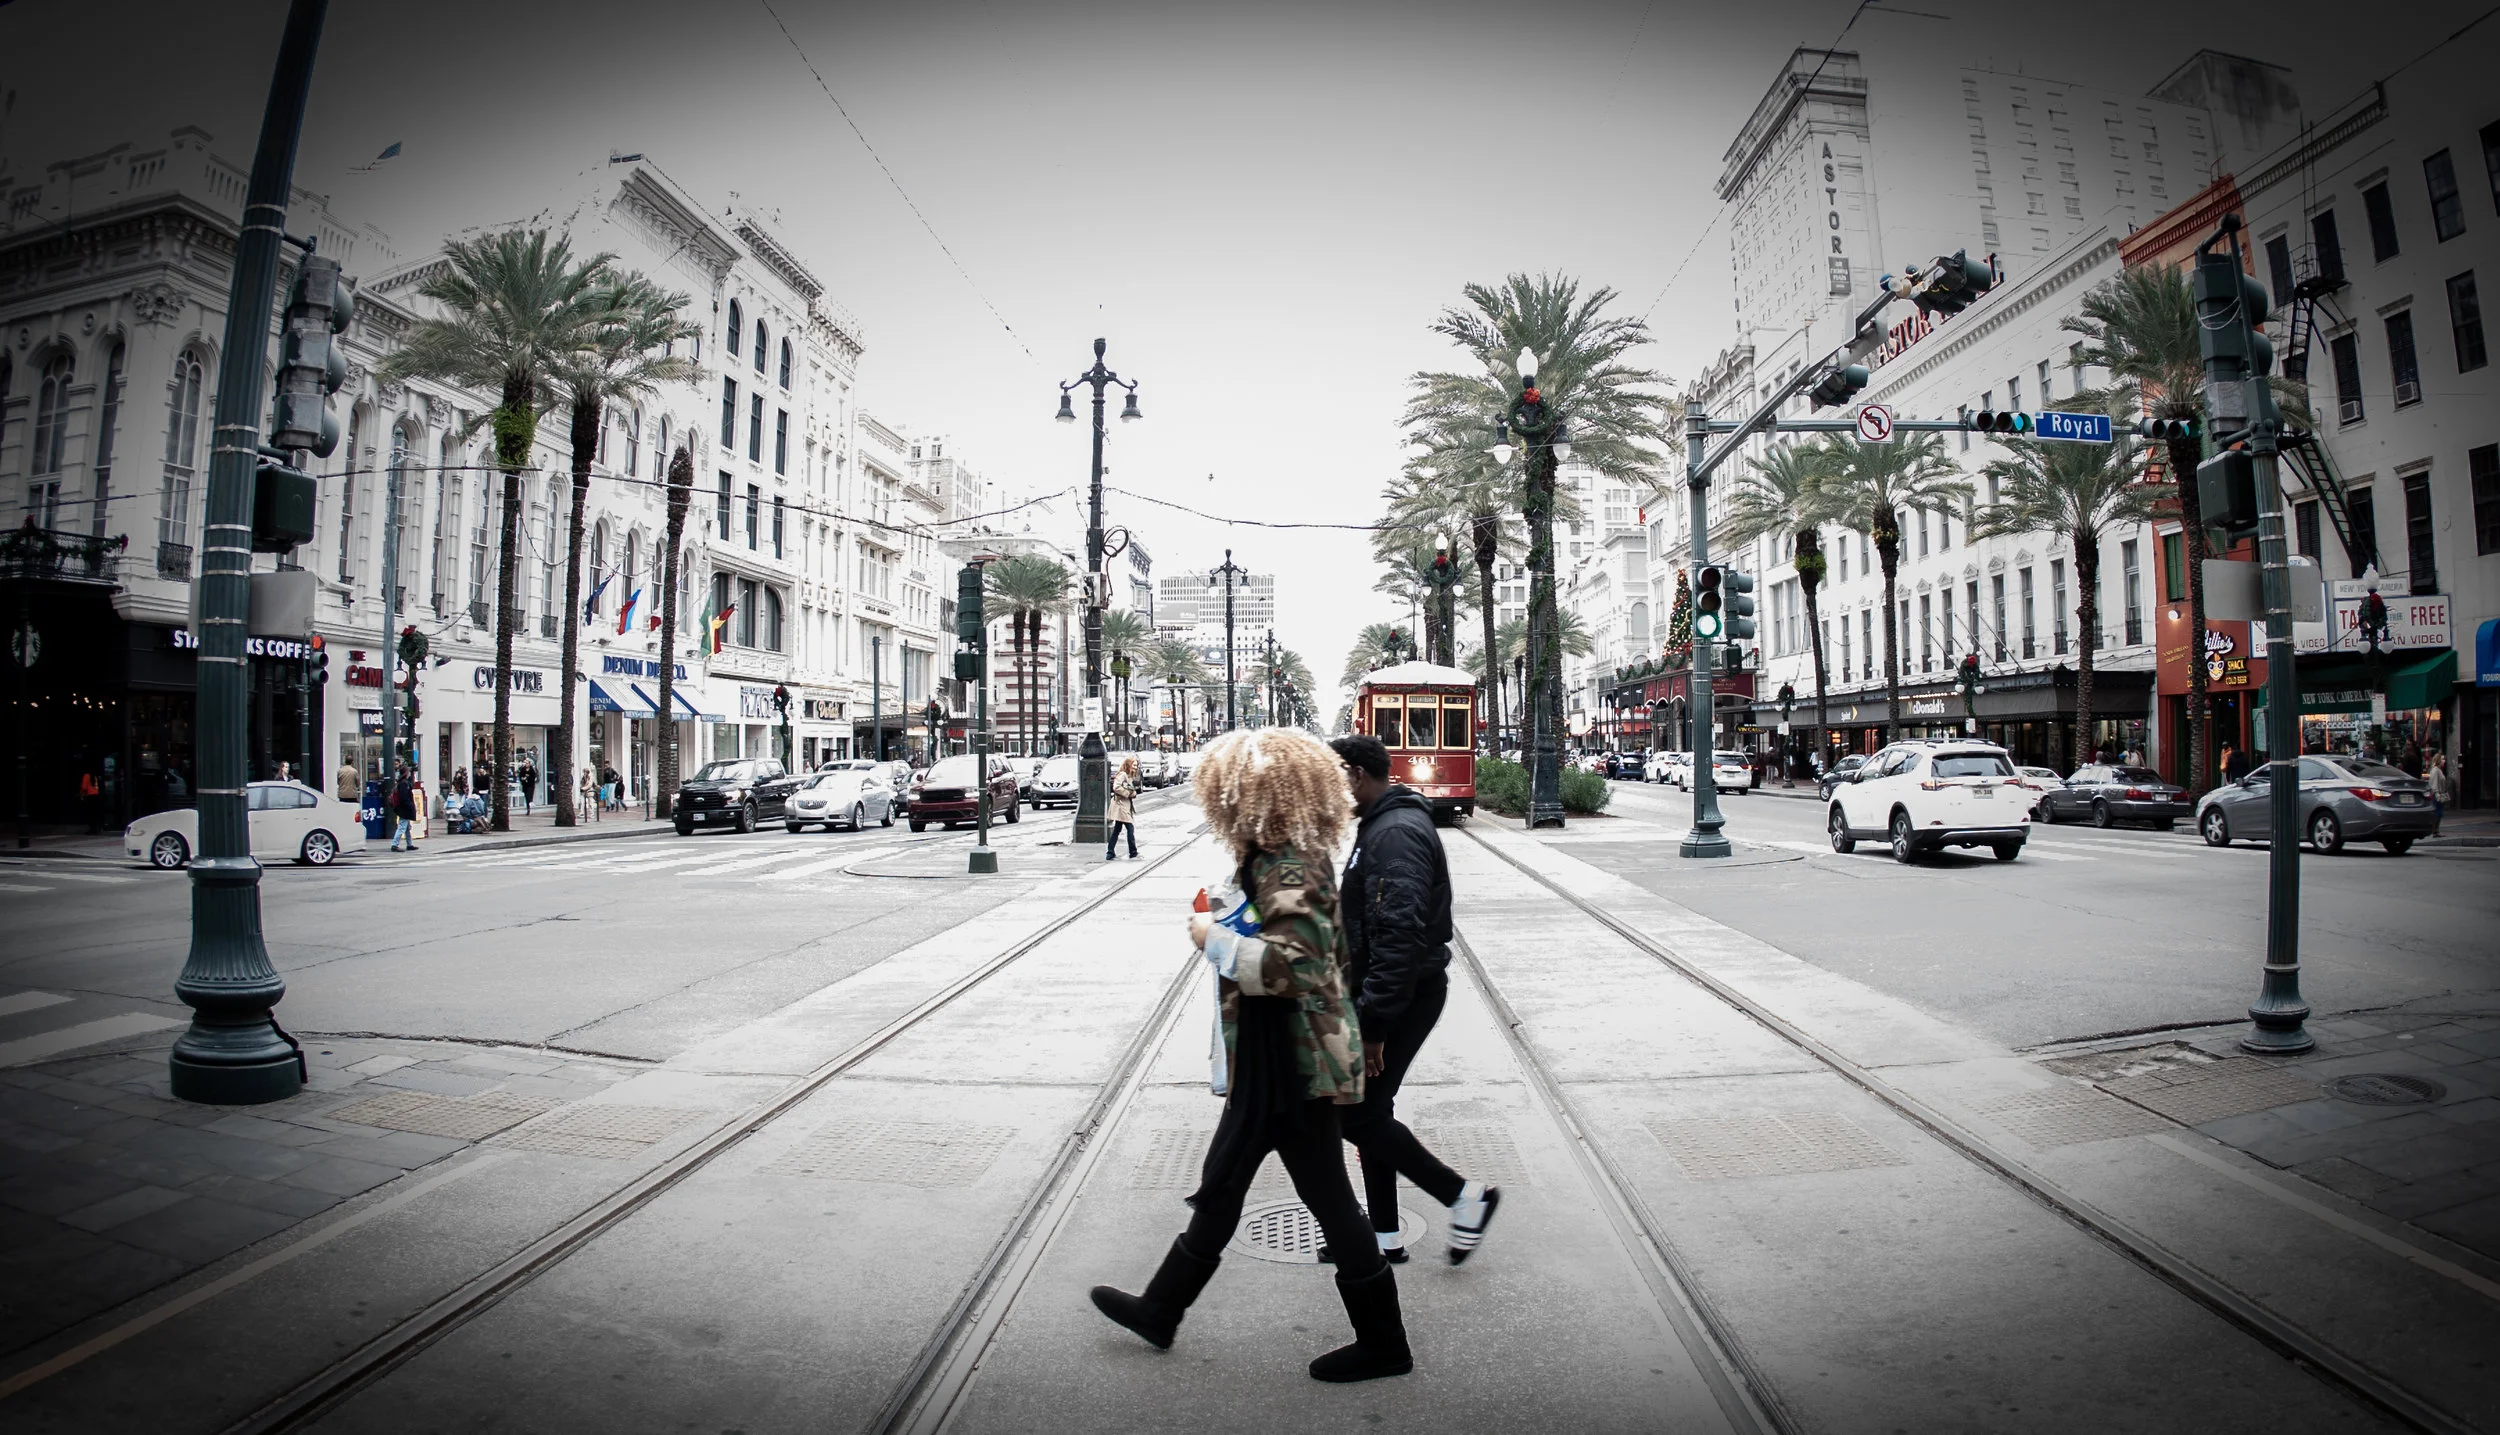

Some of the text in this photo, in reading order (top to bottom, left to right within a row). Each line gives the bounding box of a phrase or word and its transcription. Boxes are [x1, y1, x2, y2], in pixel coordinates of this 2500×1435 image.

[1822, 142, 1842, 254] ASTOR
[1878, 307, 1934, 367] ASTOR
[2051, 414, 2099, 439] Royal
[2340, 584, 2355, 593] NEW
[2410, 604, 2446, 626] FREE
[2301, 638, 2326, 649] VIDEO
[2410, 633, 2443, 645] VIDEO
[348, 650, 366, 661] THE
[603, 655, 644, 676] DENIM
[646, 660, 662, 678] DE
[2227, 659, 2244, 671] SHACK
[475, 666, 543, 693] CVVRE
[2225, 676, 2236, 685] COLD
[590, 697, 611, 705] DENIM
[2302, 693, 2316, 705] NEW
[2317, 691, 2336, 704] YORK
[2336, 689, 2363, 703] CAMERA
[1907, 699, 1945, 715] McDonald's
[1407, 755, 1436, 766] 461
